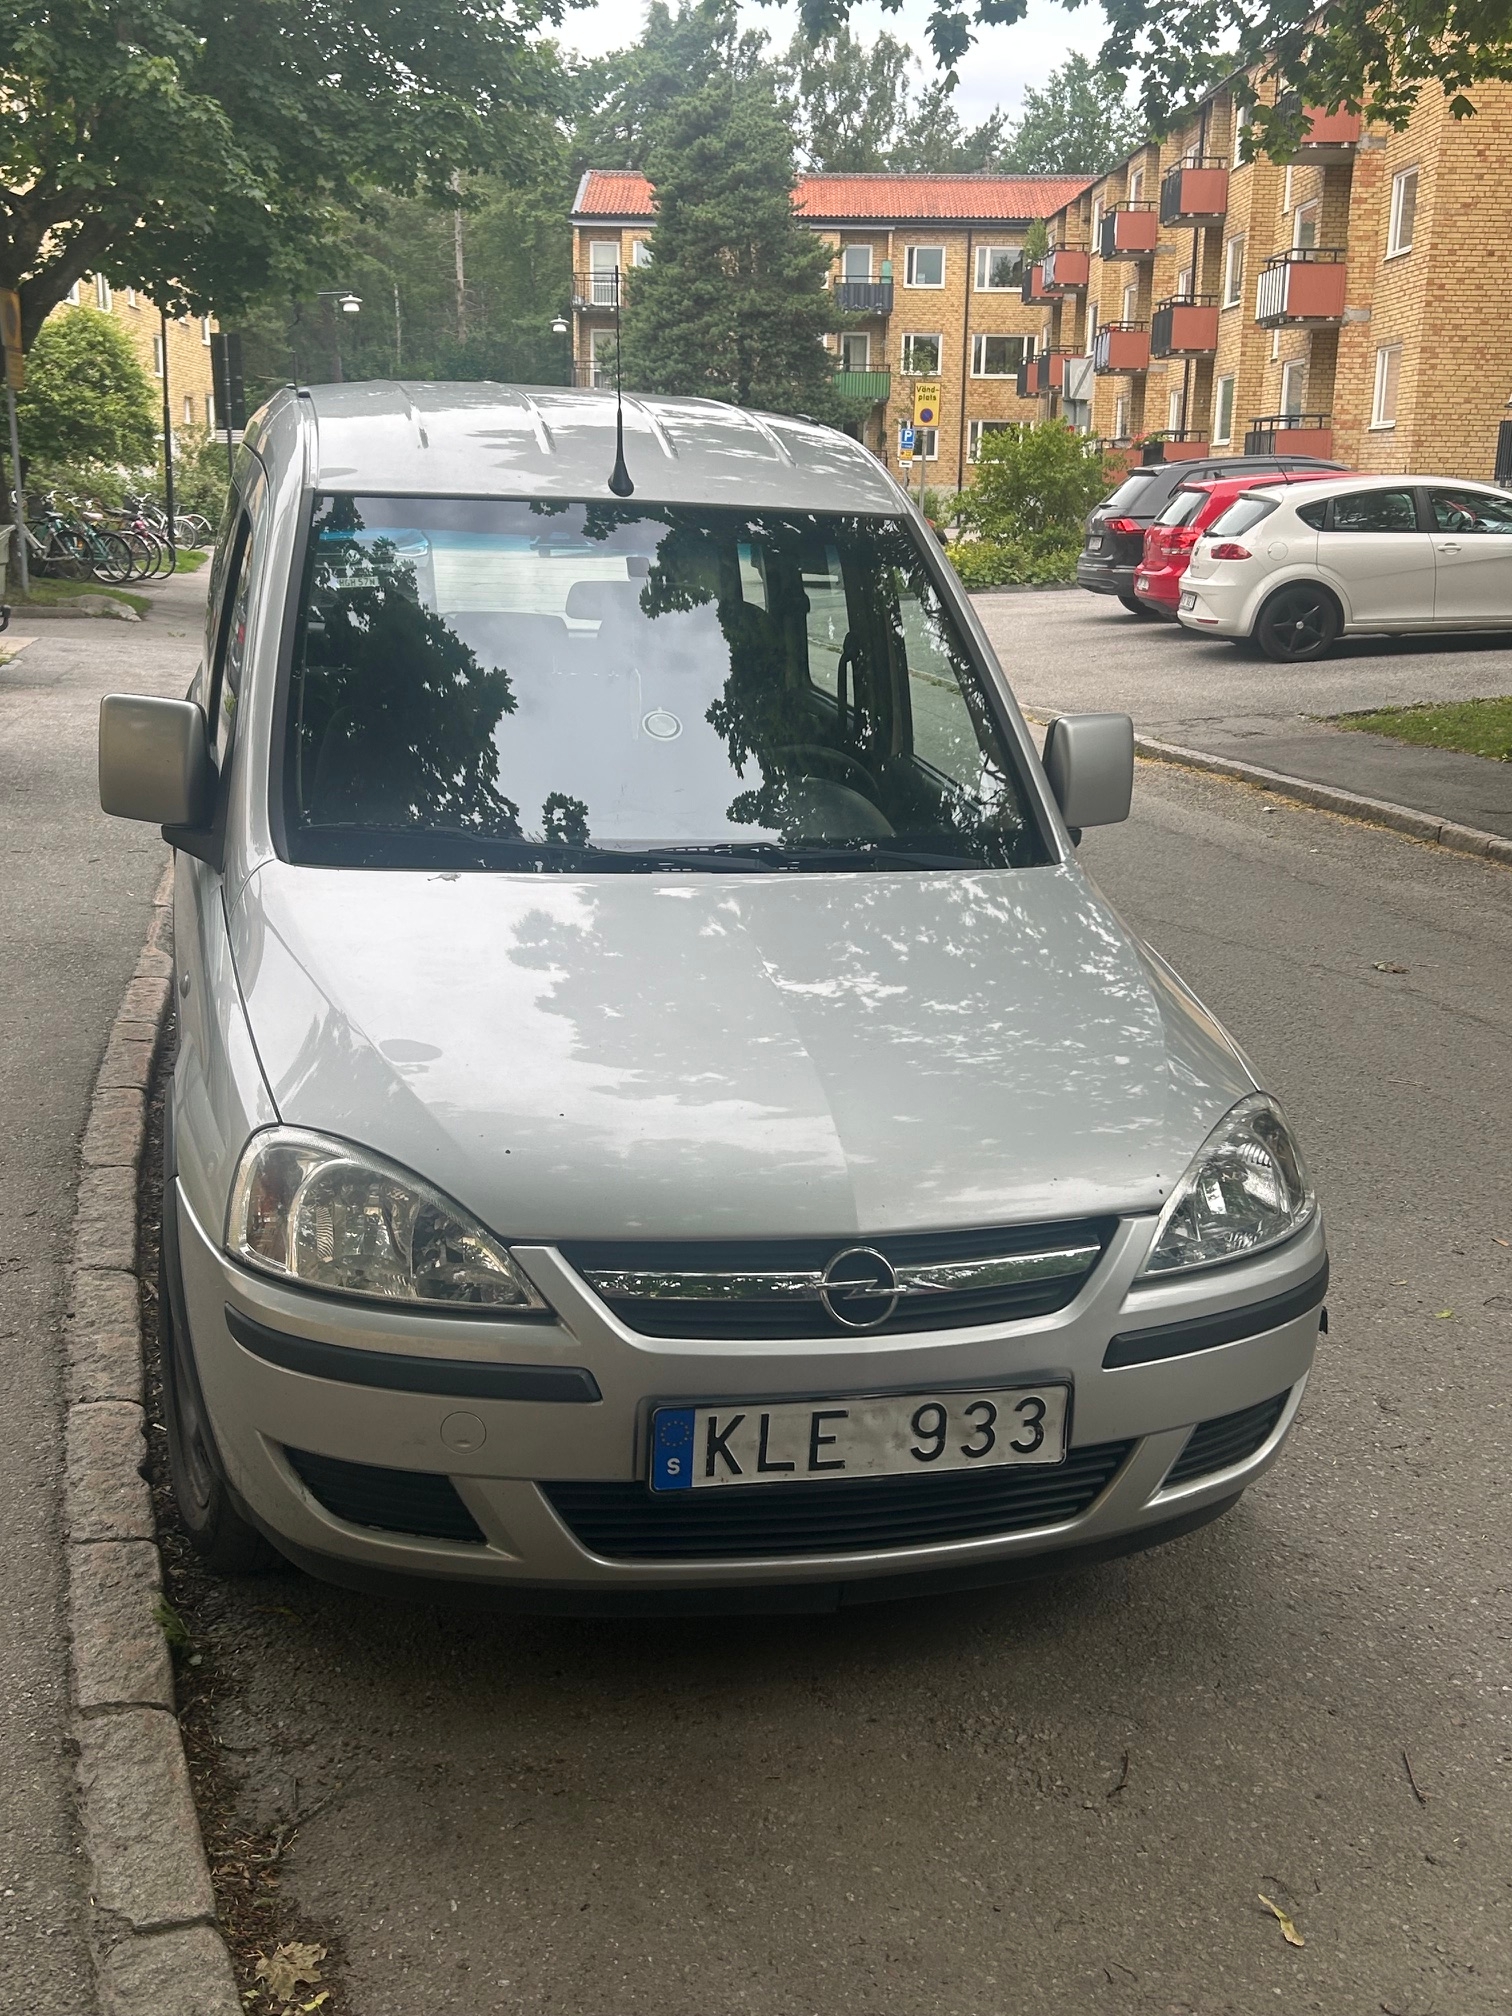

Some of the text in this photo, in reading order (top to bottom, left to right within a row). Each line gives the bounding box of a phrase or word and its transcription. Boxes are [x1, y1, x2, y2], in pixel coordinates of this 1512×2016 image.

[916, 385, 939, 393] Vänd-
[904, 430, 912, 441] P
[705, 1396, 1047, 1478] KLE 933
[667, 1458, 680, 1475] S
